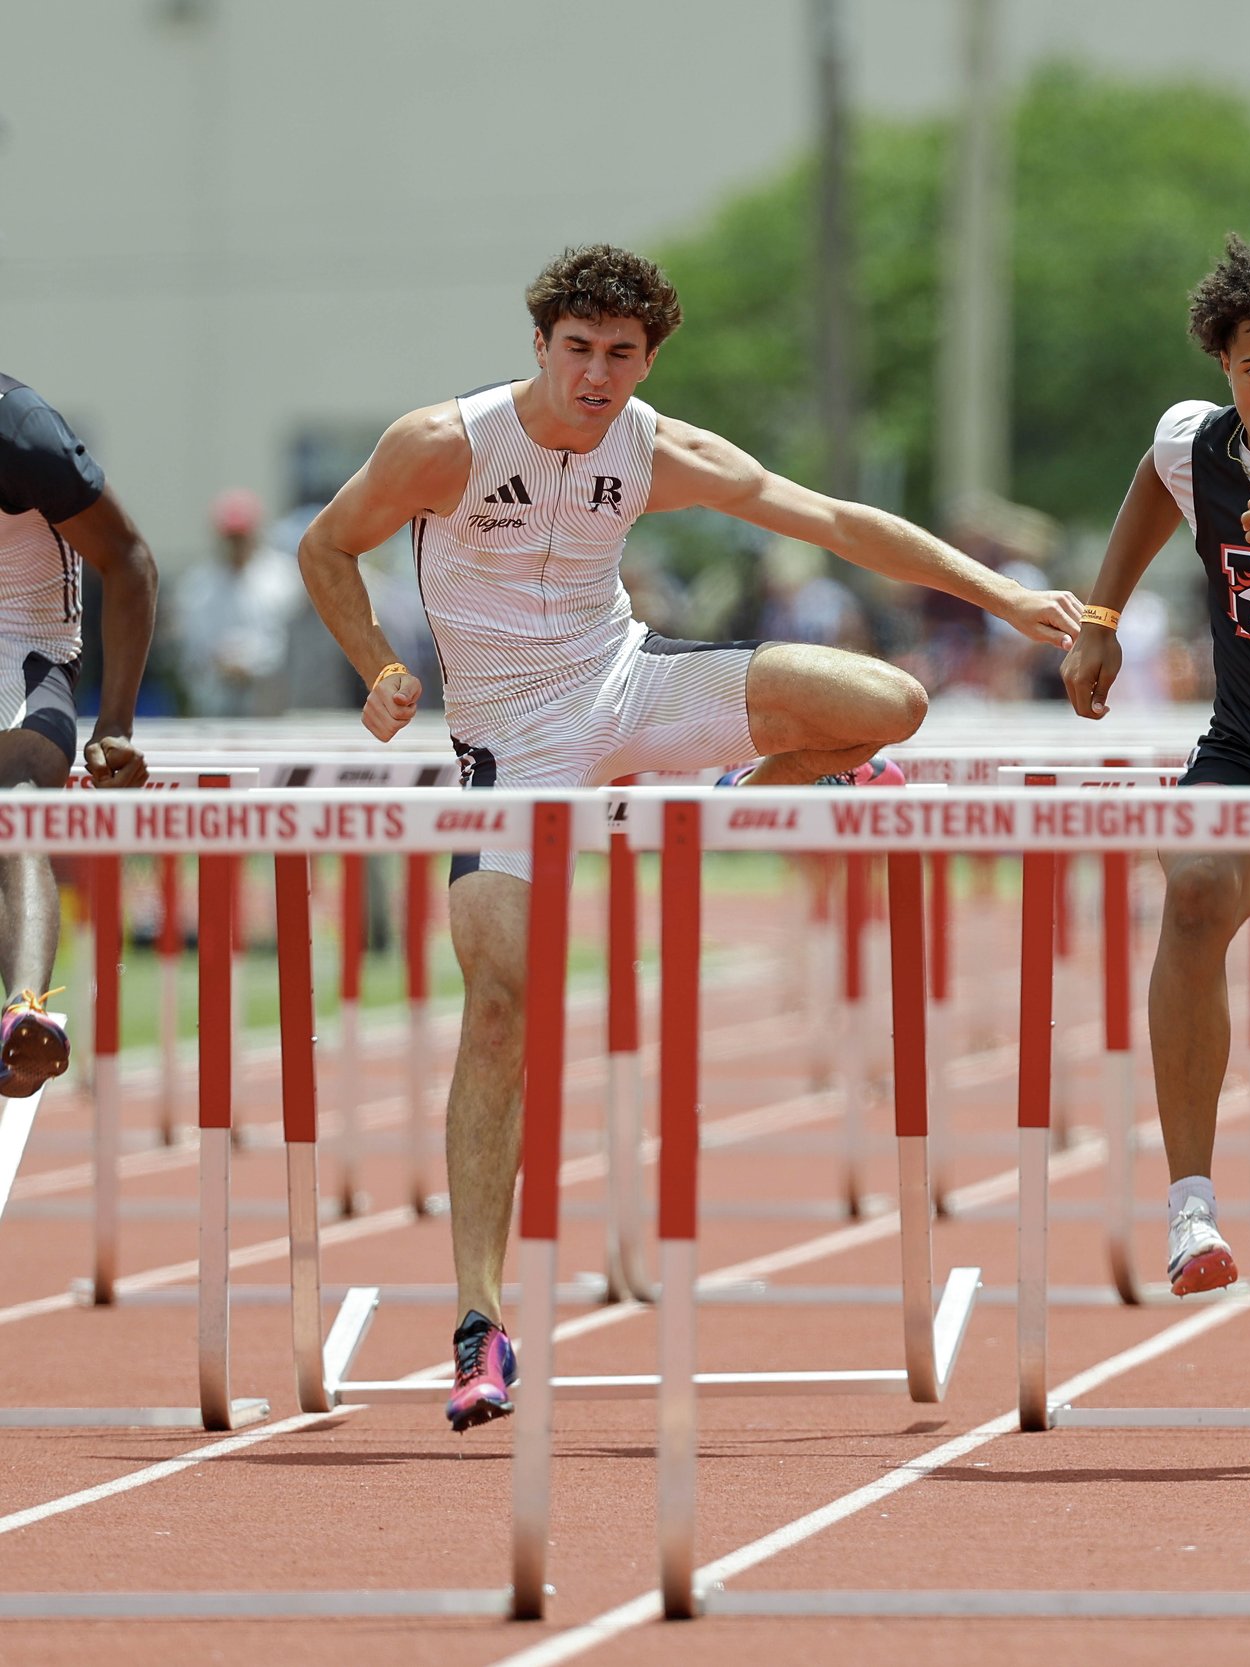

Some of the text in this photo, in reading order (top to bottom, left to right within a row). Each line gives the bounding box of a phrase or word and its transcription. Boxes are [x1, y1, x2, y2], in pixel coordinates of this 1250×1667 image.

[135, 803, 298, 840] HEIGHTS
[313, 803, 406, 840] JETS
[435, 808, 508, 833] GILL
[727, 806, 799, 831] GILL
[830, 801, 1015, 837] WESTERN
[1032, 801, 1195, 838] HEIGHTS
